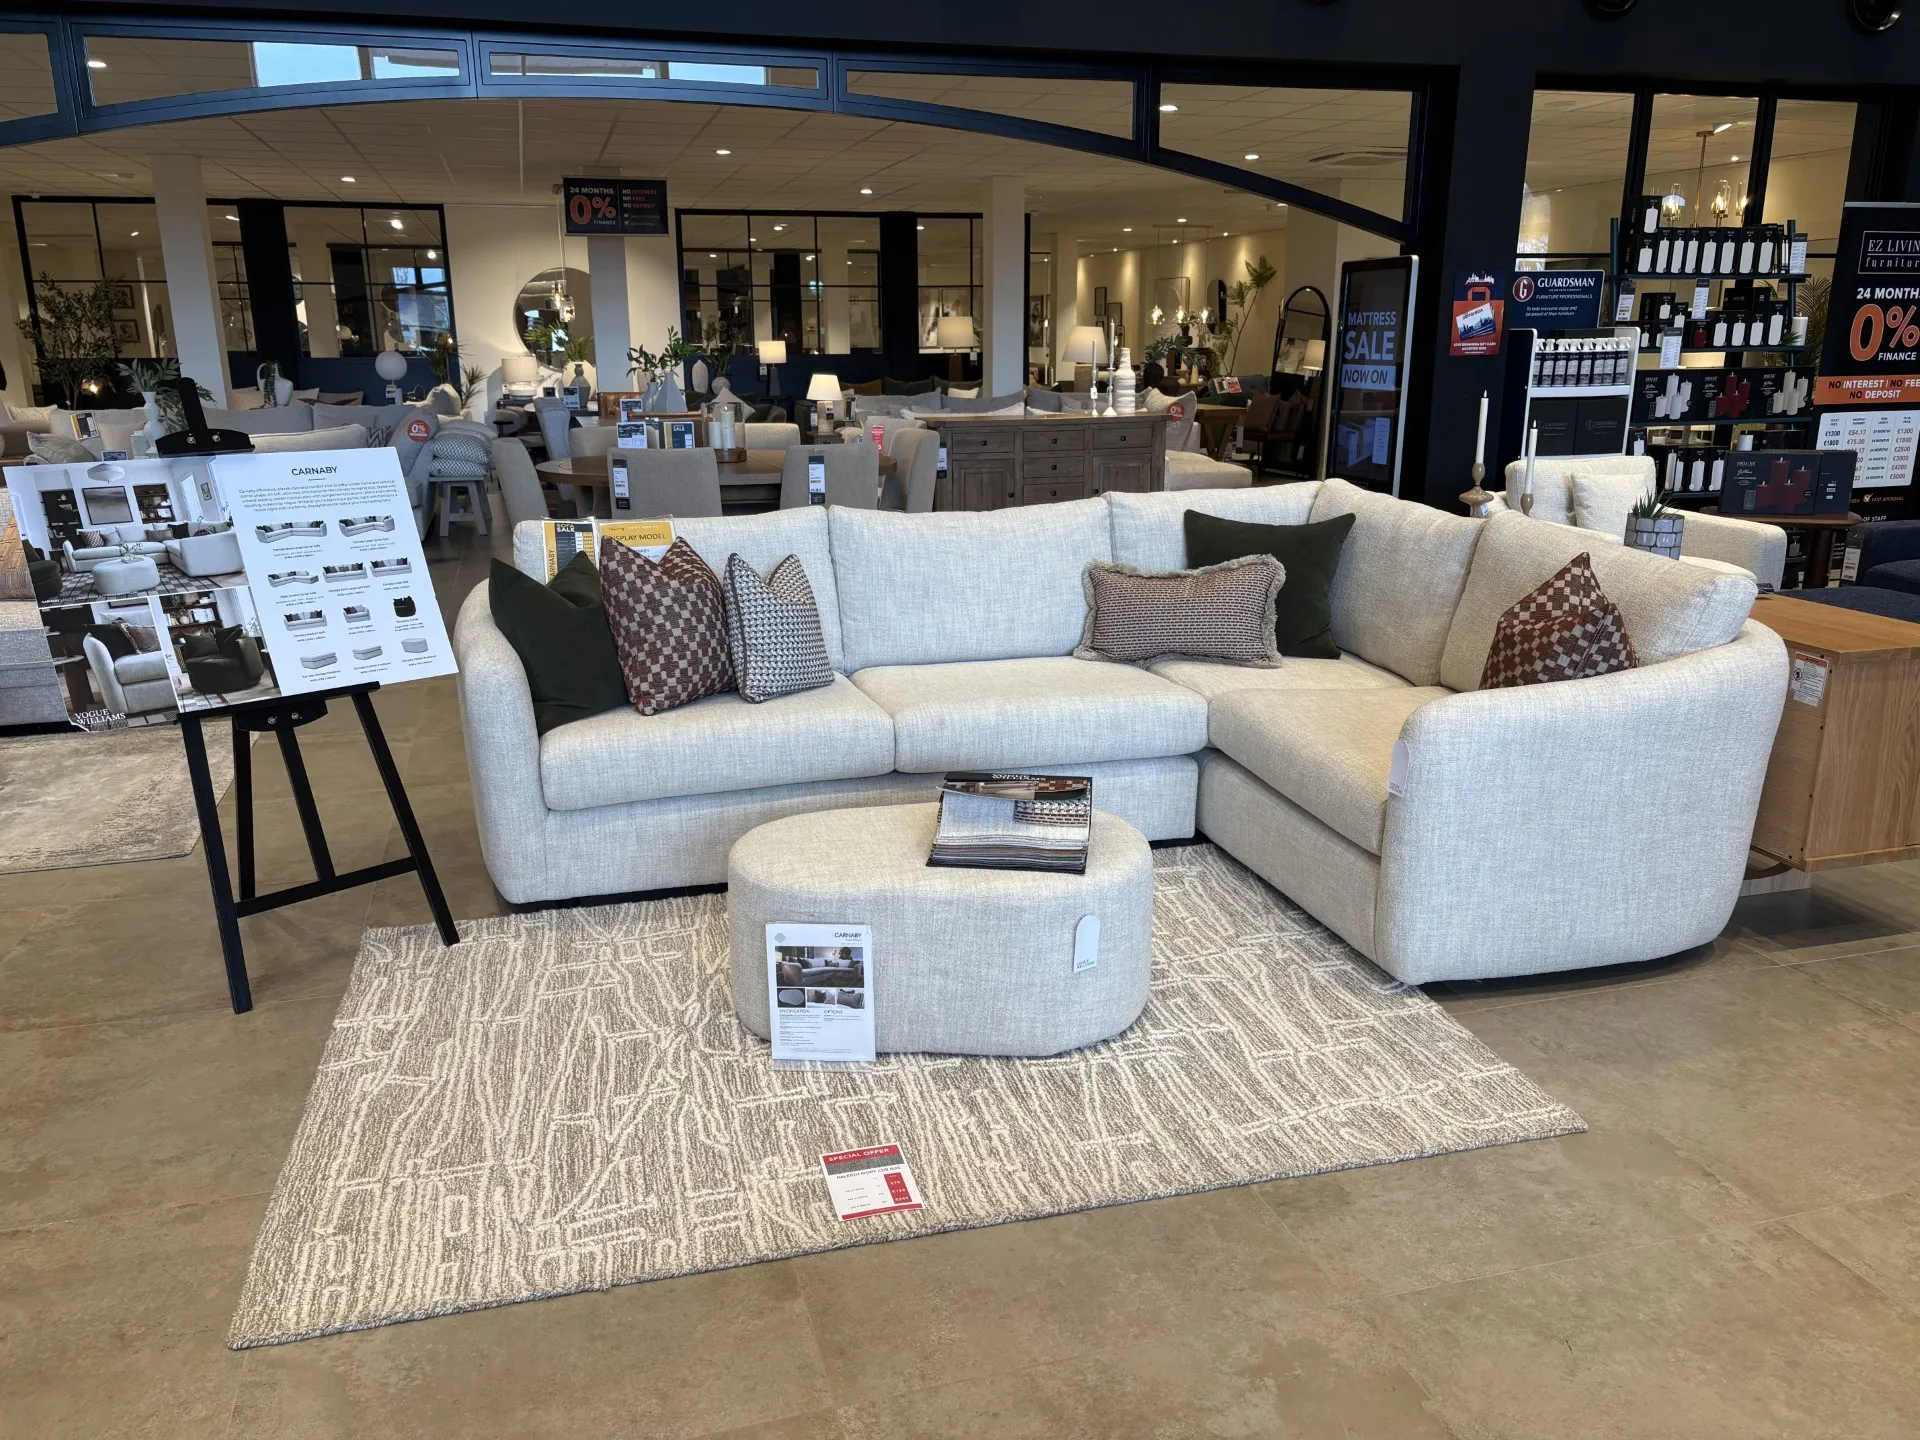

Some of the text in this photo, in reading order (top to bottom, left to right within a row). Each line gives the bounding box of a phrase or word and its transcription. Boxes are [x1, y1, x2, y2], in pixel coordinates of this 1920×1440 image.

[581, 187, 614, 195] MONTHS
[570, 194, 617, 225] 0%
[1868, 240, 1884, 252] EZ
[1865, 257, 1920, 268] furnitur
[1537, 277, 1596, 289] GUARDSMAN
[1856, 287, 1920, 299] 24 MONTH
[1348, 311, 1397, 326] MATTRESS
[1850, 303, 1920, 362] 0%
[1344, 330, 1395, 361] SALE
[1878, 351, 1917, 361] FINANCE
[1344, 369, 1388, 384] NOW ON
[1828, 380, 1842, 389] NO
[1843, 379, 1885, 388] INTEREST
[1890, 379, 1903, 388] NO
[1849, 389, 1902, 399] NO DEPOSIT
[411, 424, 426, 433] 0%
[291, 466, 338, 476] CARNABY
[74, 708, 110, 720] VOGUE
[76, 712, 127, 725] WILLIAMS
[828, 1148, 890, 1162] SPECIAL OFFER
